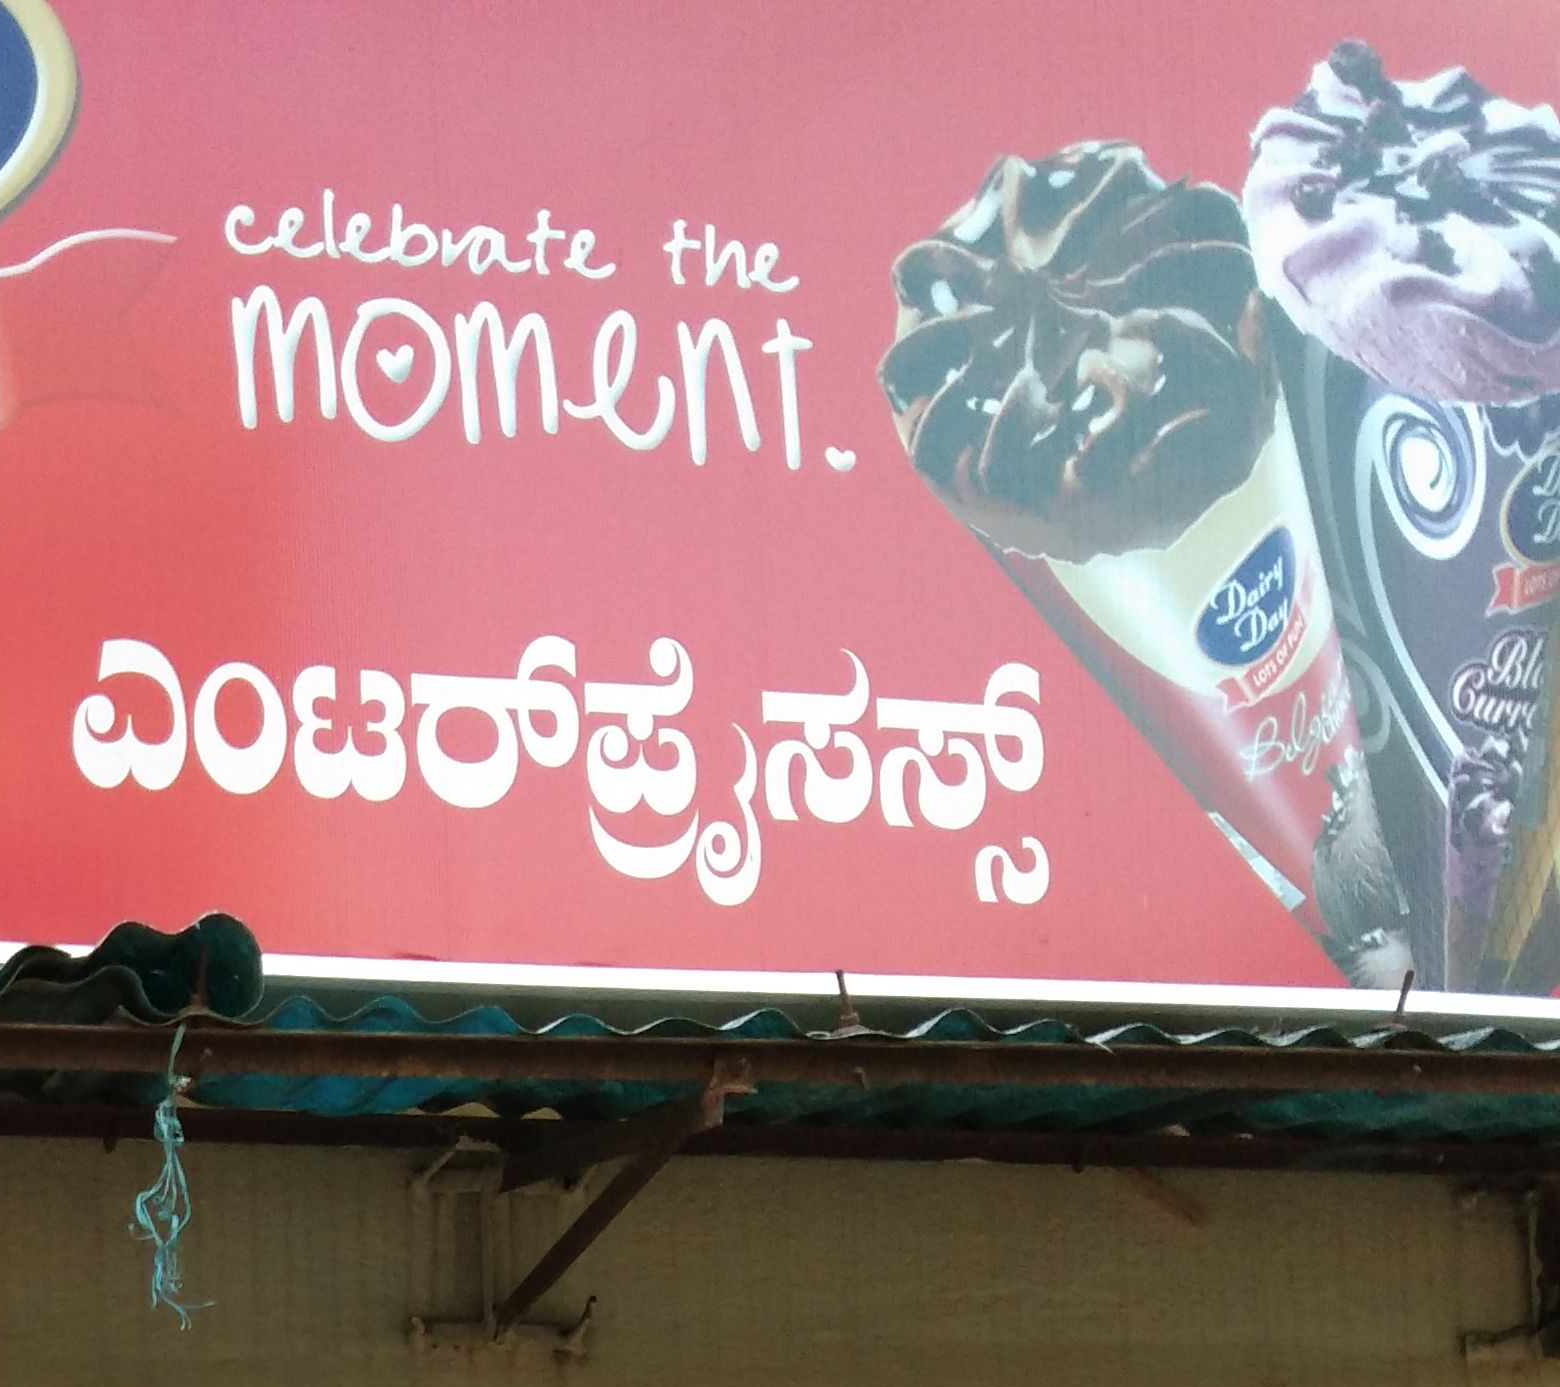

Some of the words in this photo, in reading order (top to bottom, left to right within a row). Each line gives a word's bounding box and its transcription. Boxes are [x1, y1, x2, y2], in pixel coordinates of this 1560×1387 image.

[224, 188, 616, 283] celebrate
[663, 218, 798, 295] the
[1210, 555, 1283, 624] Dairy
[1235, 599, 1288, 652] Day
